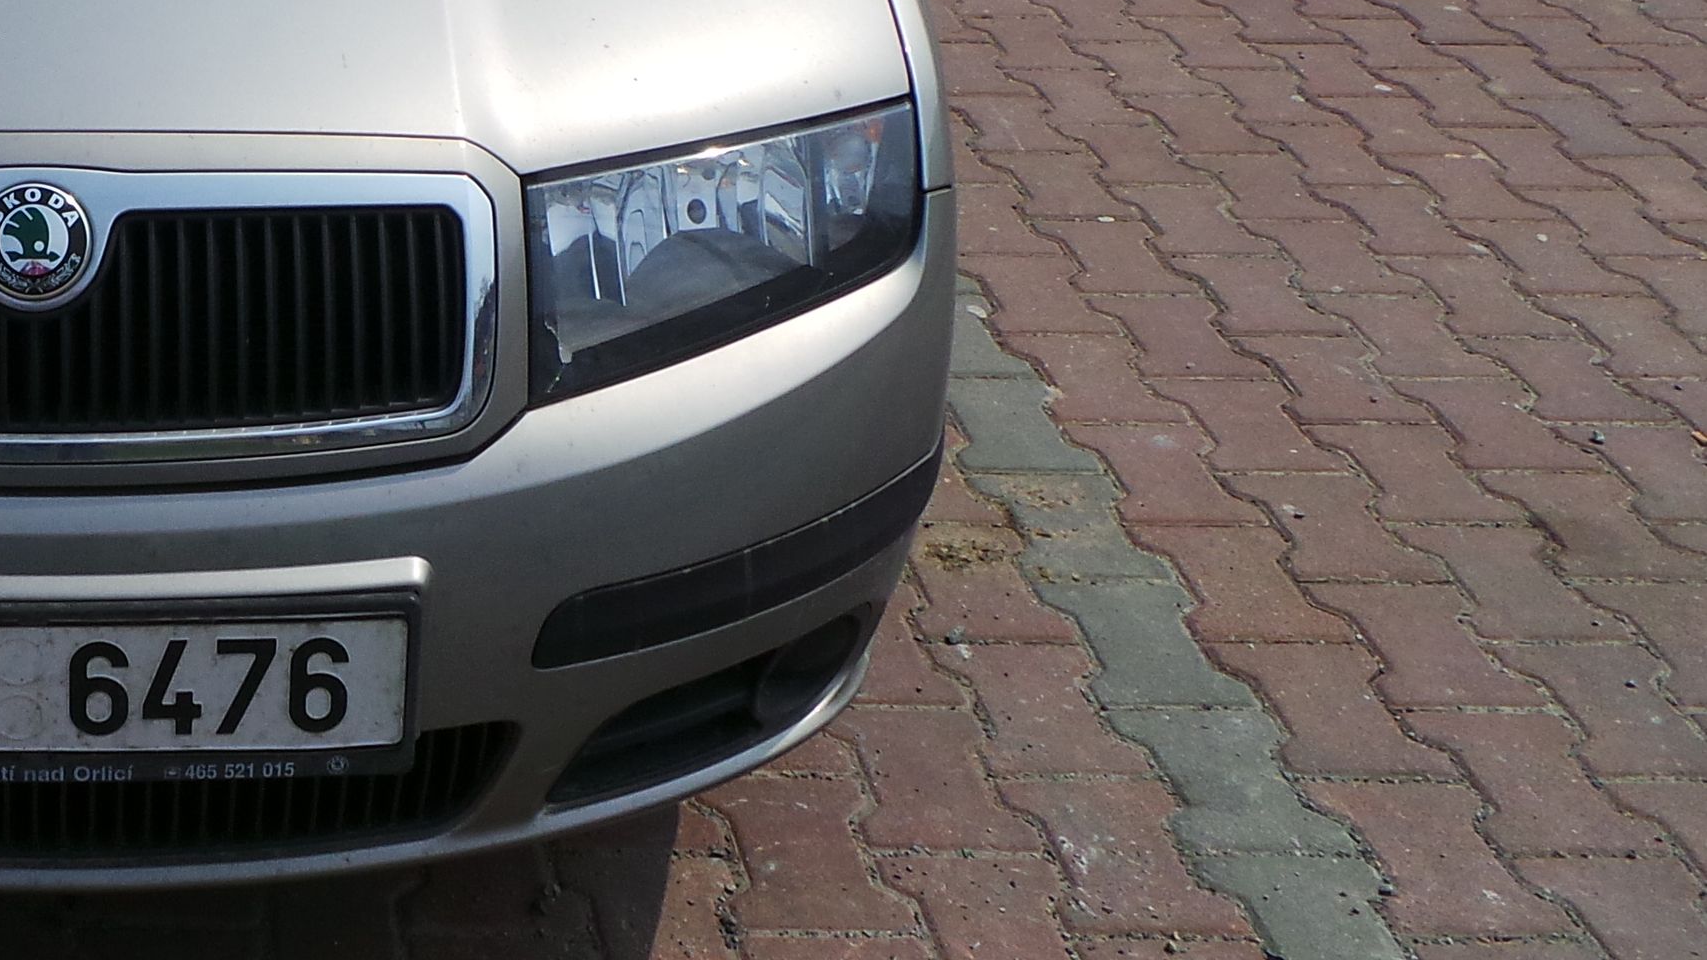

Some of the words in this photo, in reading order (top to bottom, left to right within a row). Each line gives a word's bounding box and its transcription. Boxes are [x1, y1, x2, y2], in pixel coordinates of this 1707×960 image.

[69, 637, 350, 736] 6476
[23, 766, 65, 782] nad
[73, 764, 134, 782] Orlicí
[185, 764, 218, 780] 465
[224, 763, 255, 779] 521
[262, 761, 295, 778] 015
